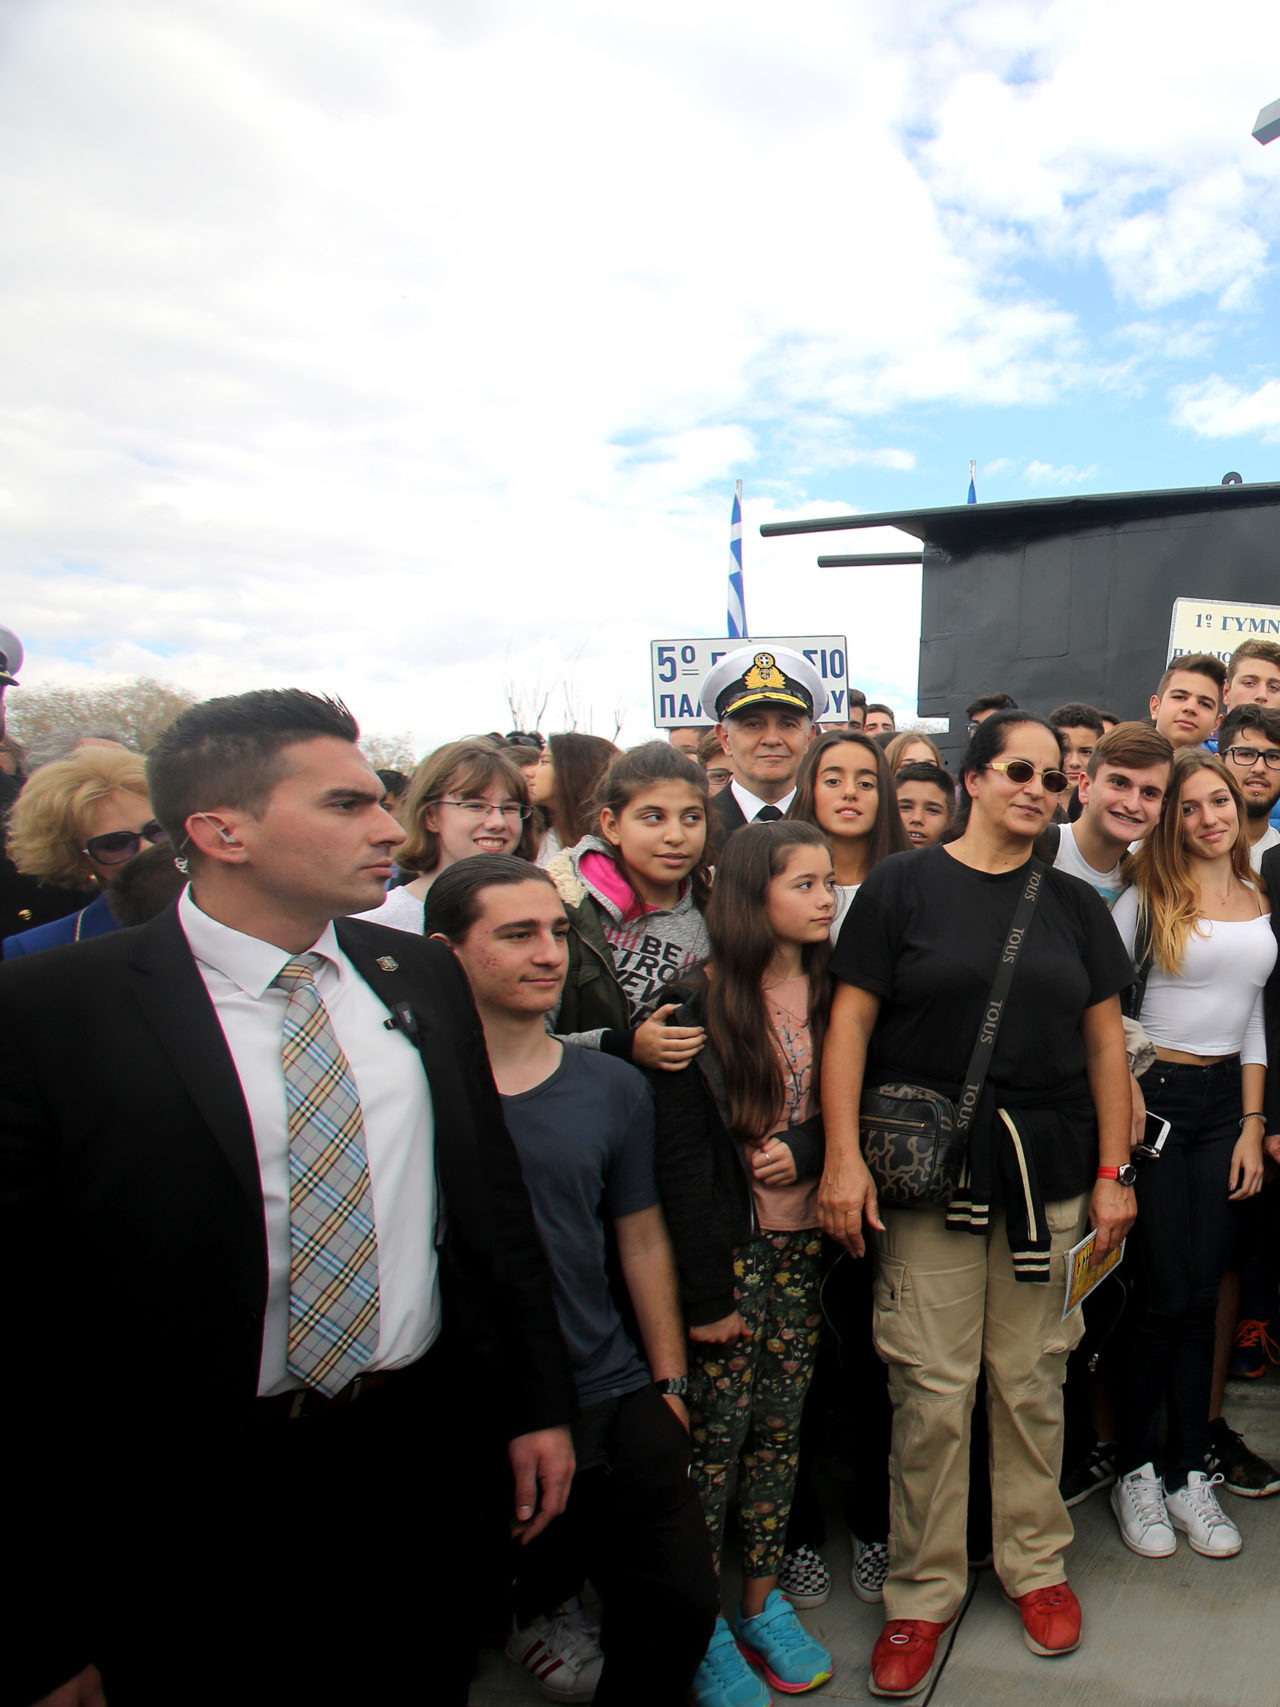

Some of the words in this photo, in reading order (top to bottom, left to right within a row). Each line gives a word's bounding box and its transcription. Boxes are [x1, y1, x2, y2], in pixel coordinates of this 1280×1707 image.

[1024, 871, 1041, 902] TOUS
[640, 934, 682, 966] BE
[1002, 927, 1024, 964] TOUS
[981, 1000, 1002, 1044] TOUS
[957, 1083, 980, 1129] TOUS
